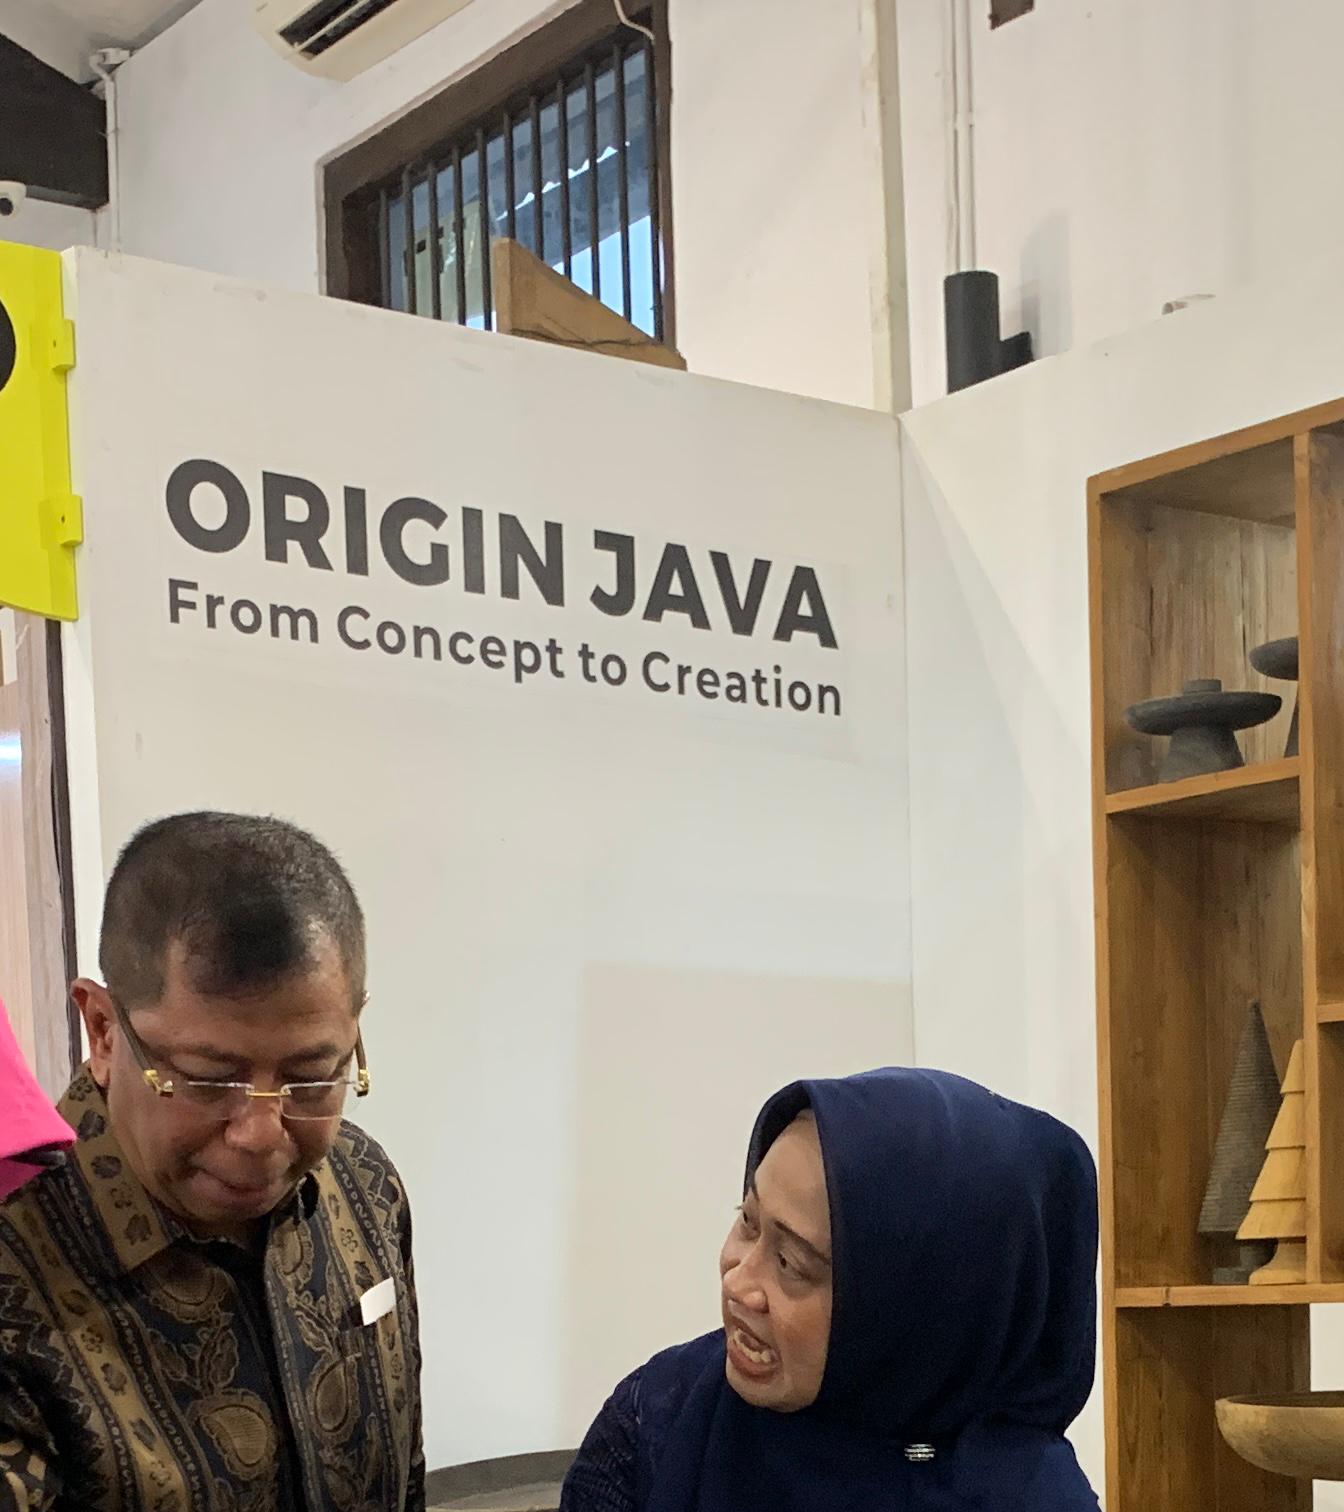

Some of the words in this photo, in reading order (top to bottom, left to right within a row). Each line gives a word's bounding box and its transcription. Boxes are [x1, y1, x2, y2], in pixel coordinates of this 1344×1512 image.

[165, 458, 565, 607] ORIGIN
[590, 529, 839, 649] JAVA
[168, 578, 320, 643] From
[337, 606, 565, 683] Concept
[578, 643, 628, 686] to
[642, 651, 842, 716] Creation
